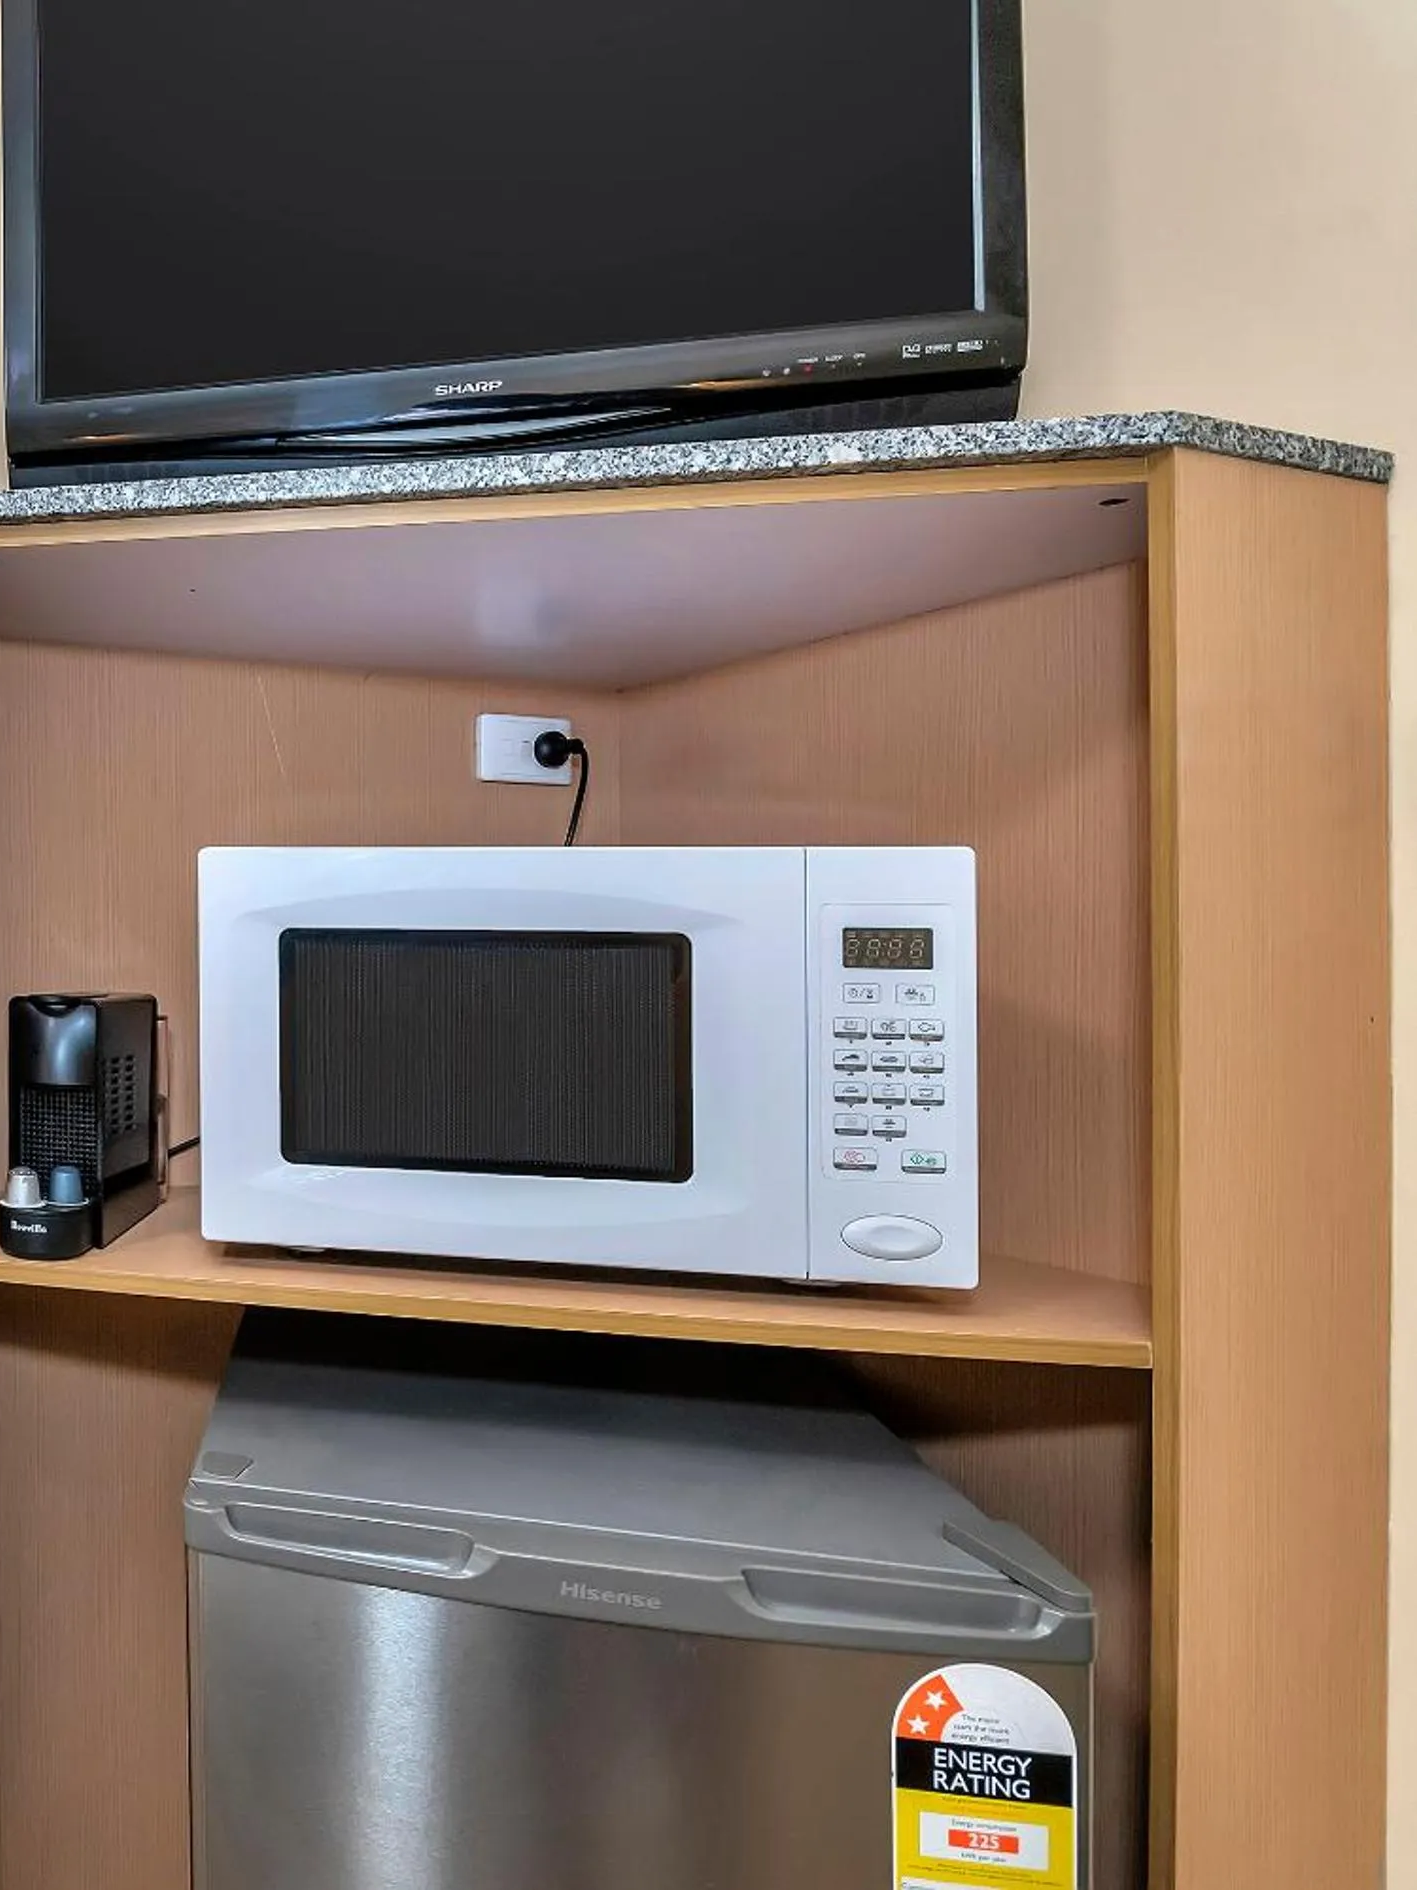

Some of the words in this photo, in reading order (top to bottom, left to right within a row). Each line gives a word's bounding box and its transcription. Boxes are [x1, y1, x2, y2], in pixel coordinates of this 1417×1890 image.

[434, 380, 503, 396] SHARP
[560, 1580, 664, 1610] Hisense
[933, 1748, 1032, 1777] ENERGY
[933, 1770, 1031, 1799] RATING
[967, 1832, 1000, 1850] 225
